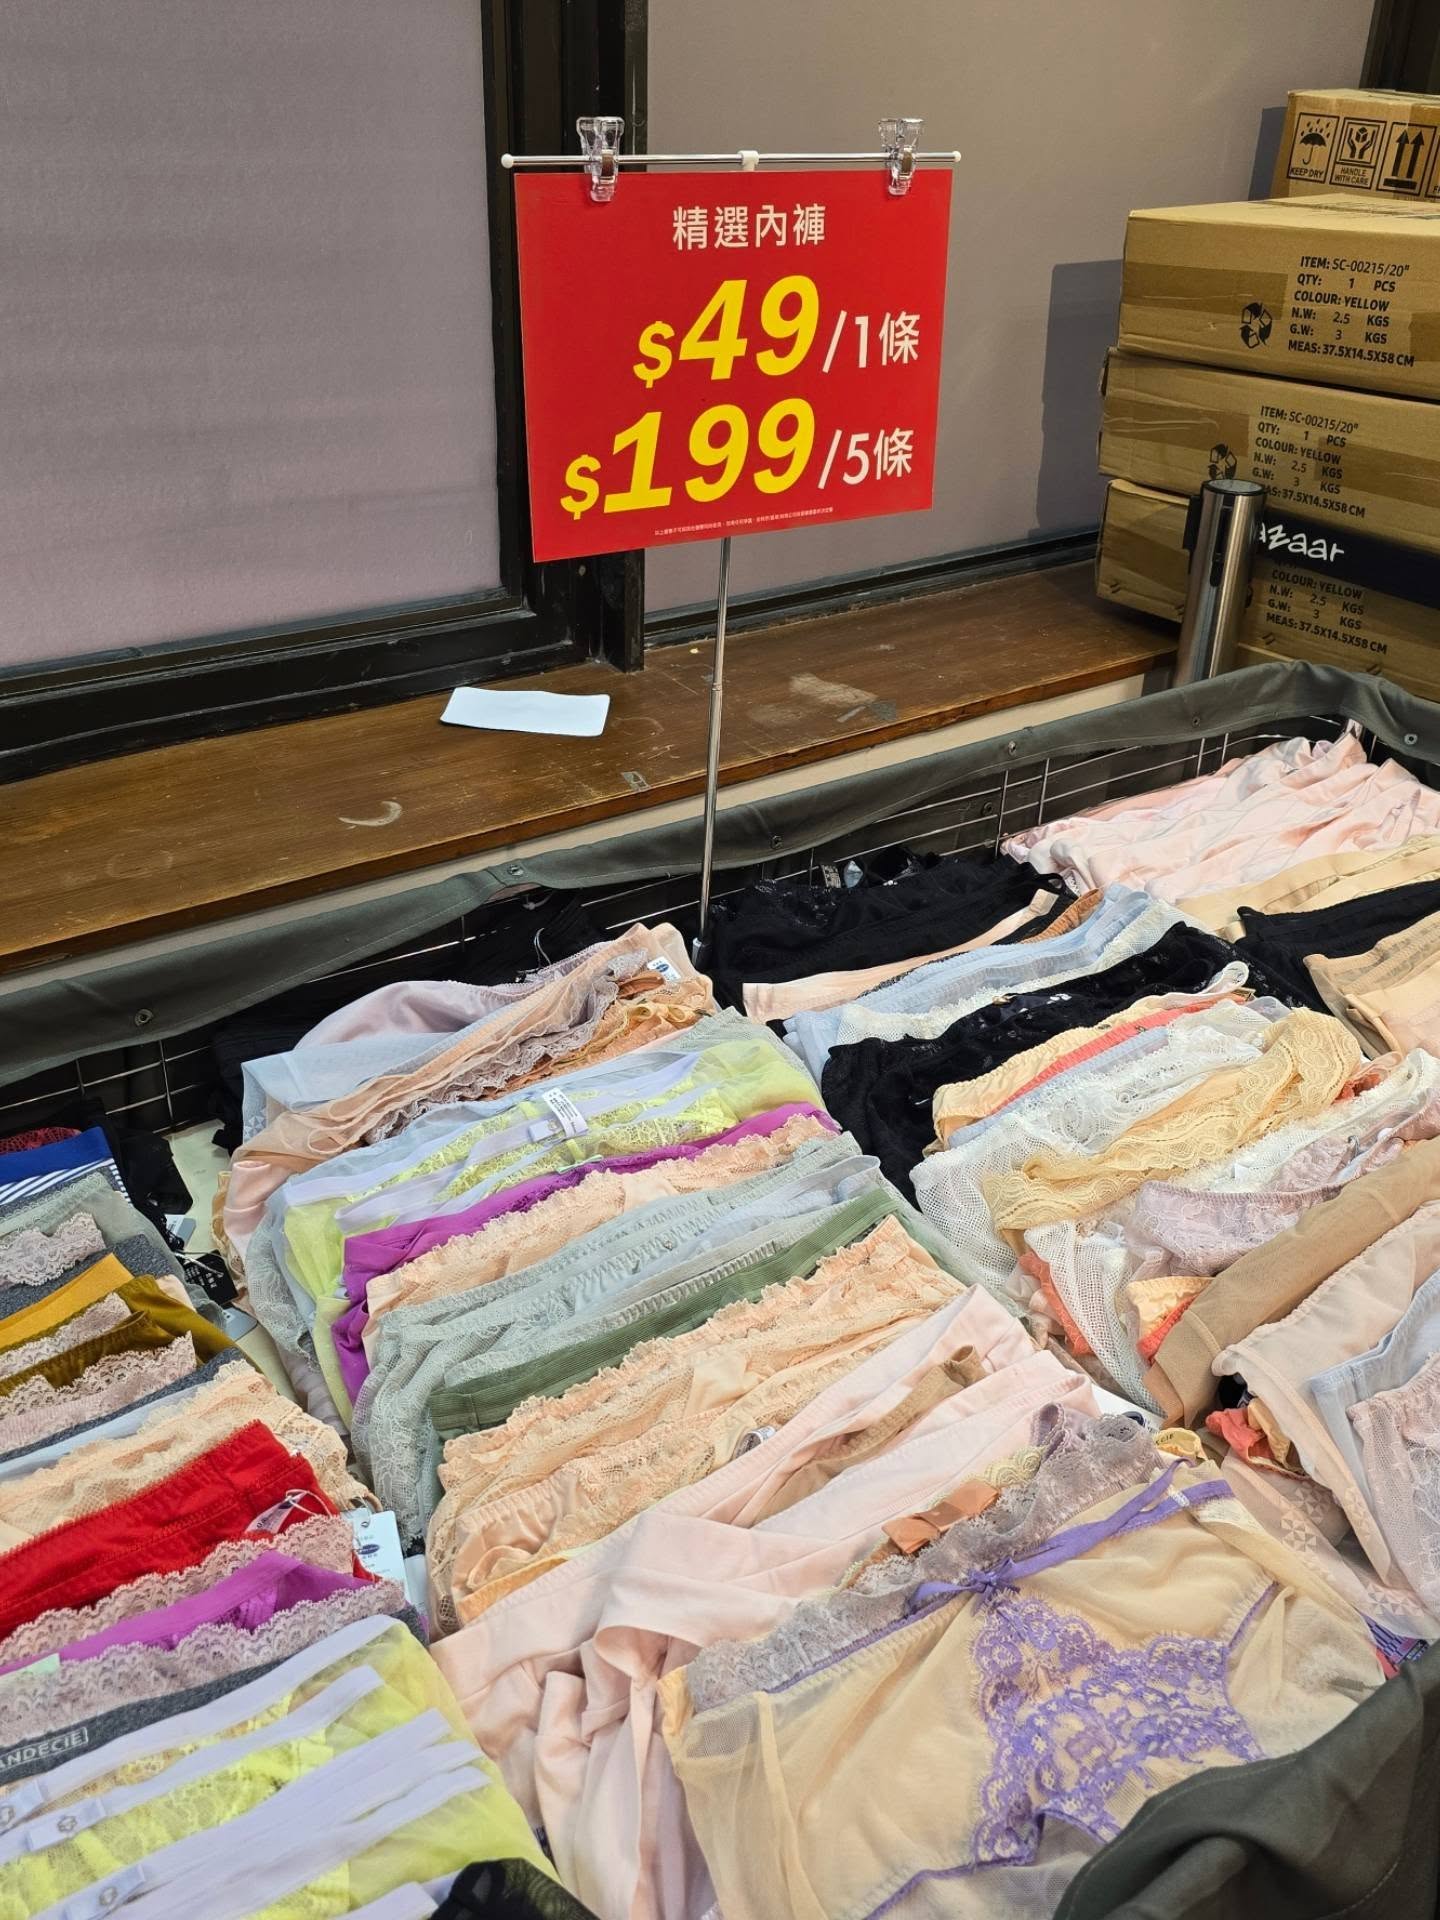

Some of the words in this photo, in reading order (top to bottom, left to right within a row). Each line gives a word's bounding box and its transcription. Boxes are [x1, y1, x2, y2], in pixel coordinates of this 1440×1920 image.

[1290, 167, 1307, 177] KEEP
[1307, 169, 1325, 179] DRY
[1334, 173, 1350, 183] WITH
[1349, 176, 1369, 186] CARE
[1340, 167, 1367, 177] HANDLE
[1300, 256, 1331, 269] ITEM:
[1297, 274, 1322, 286] QTY:
[1348, 277, 1354, 289] 1
[1374, 280, 1395, 292] PCS
[1295, 291, 1341, 306] COLOUR:
[1344, 295, 1389, 311] YELLOW
[1292, 308, 1316, 320] N.W:
[1333, 311, 1350, 324] 2.5
[1367, 314, 1389, 327] KGS
[1290, 324, 1313, 336] G.W:
[1336, 329, 1342, 340] 3
[1365, 331, 1387, 344] KGS
[1288, 340, 1321, 353] MEAS:
[1322, 343, 1394, 364] 37.5X14.5X58
[1396, 354, 1414, 367] CM
[1261, 405, 1287, 420] ITEM:
[1258, 423, 1279, 436] QTY:
[1304, 431, 1309, 440] 1
[1327, 435, 1346, 447] PCS
[1256, 437, 1298, 454] COLOUR:
[1300, 447, 1341, 464] YELLOW
[1254, 453, 1276, 466] N.W:
[1291, 460, 1307, 472] 2.5
[1322, 467, 1342, 479] KGS
[1252, 468, 1274, 480] G.W:
[1294, 477, 1299, 487] 3
[1320, 481, 1341, 494] KGS
[1265, 484, 1281, 499] AS:
[1349, 505, 1365, 518] CM
[1272, 569, 1317, 589] COLOUR:
[1319, 581, 1363, 600] YELLOW
[1270, 586, 1293, 598] N.W:
[1310, 593, 1326, 606] 2.5
[1342, 601, 1364, 615] KGS
[1268, 599, 1290, 612] G.W:
[1314, 609, 1319, 619] 3
[1340, 616, 1361, 629] KGS
[1266, 612, 1298, 629] MEAS:
[1369, 641, 1387, 655] CM
